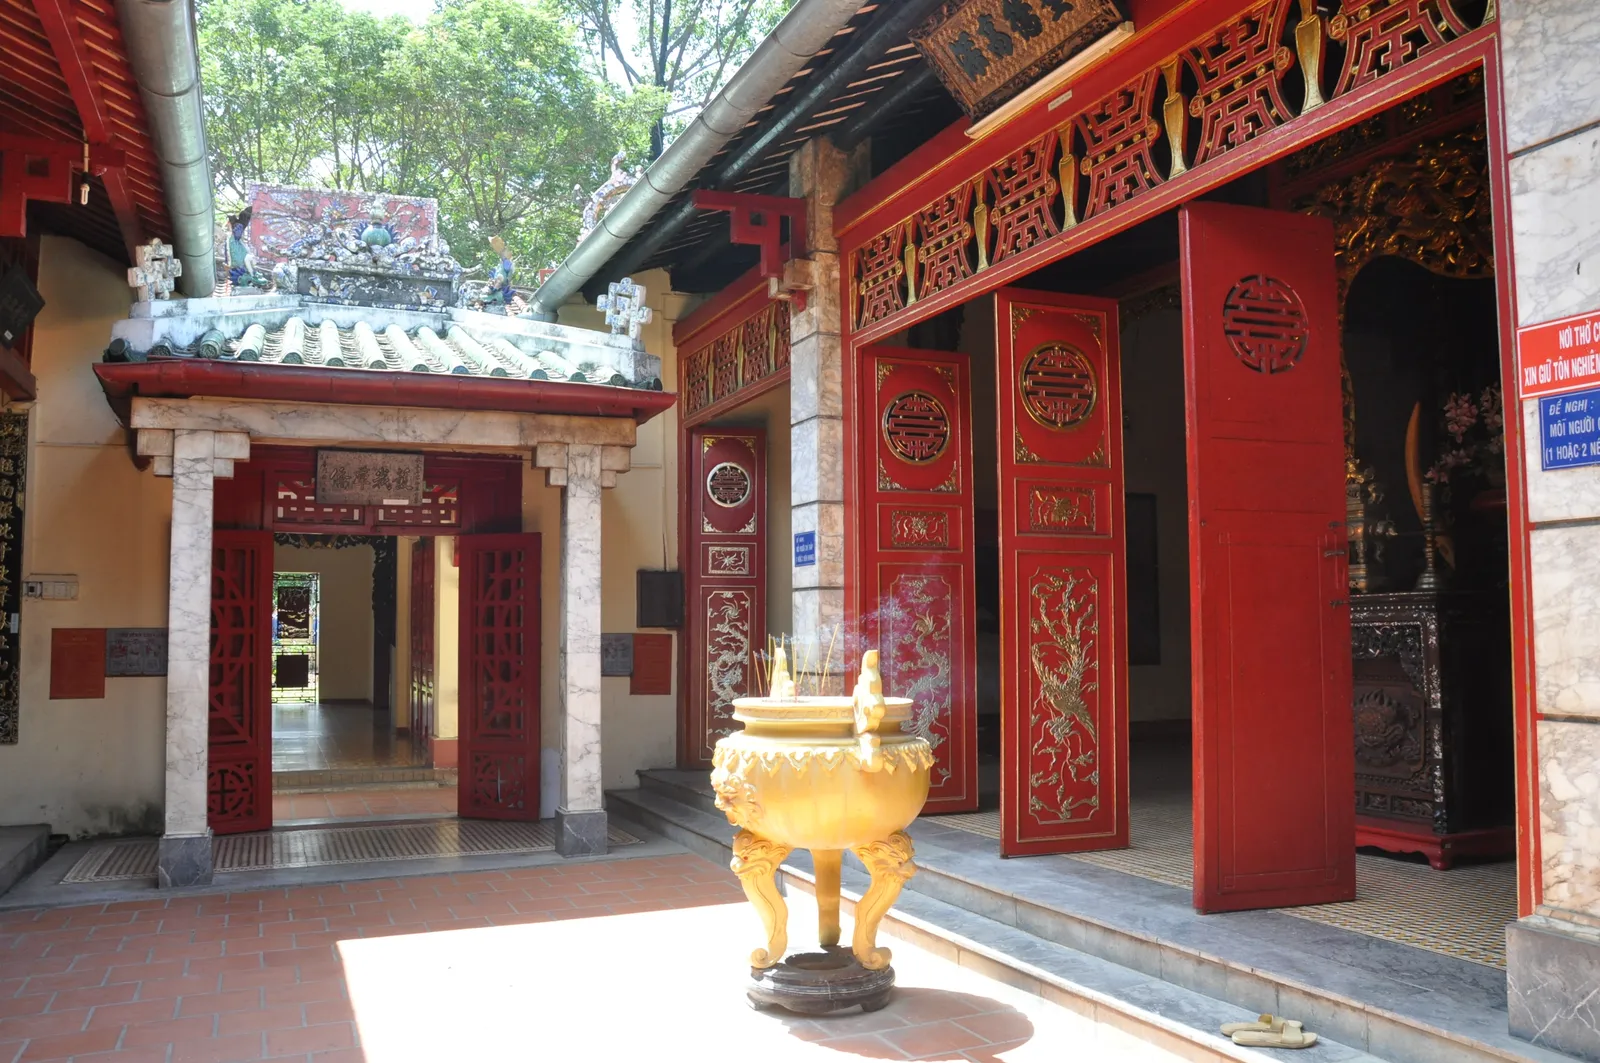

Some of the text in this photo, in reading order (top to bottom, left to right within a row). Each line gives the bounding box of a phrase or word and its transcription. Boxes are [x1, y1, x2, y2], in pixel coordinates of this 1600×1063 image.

[1524, 366, 1537, 386] XIN
[1553, 355, 1570, 381] TÔN
[1581, 443, 1587, 457] 2
